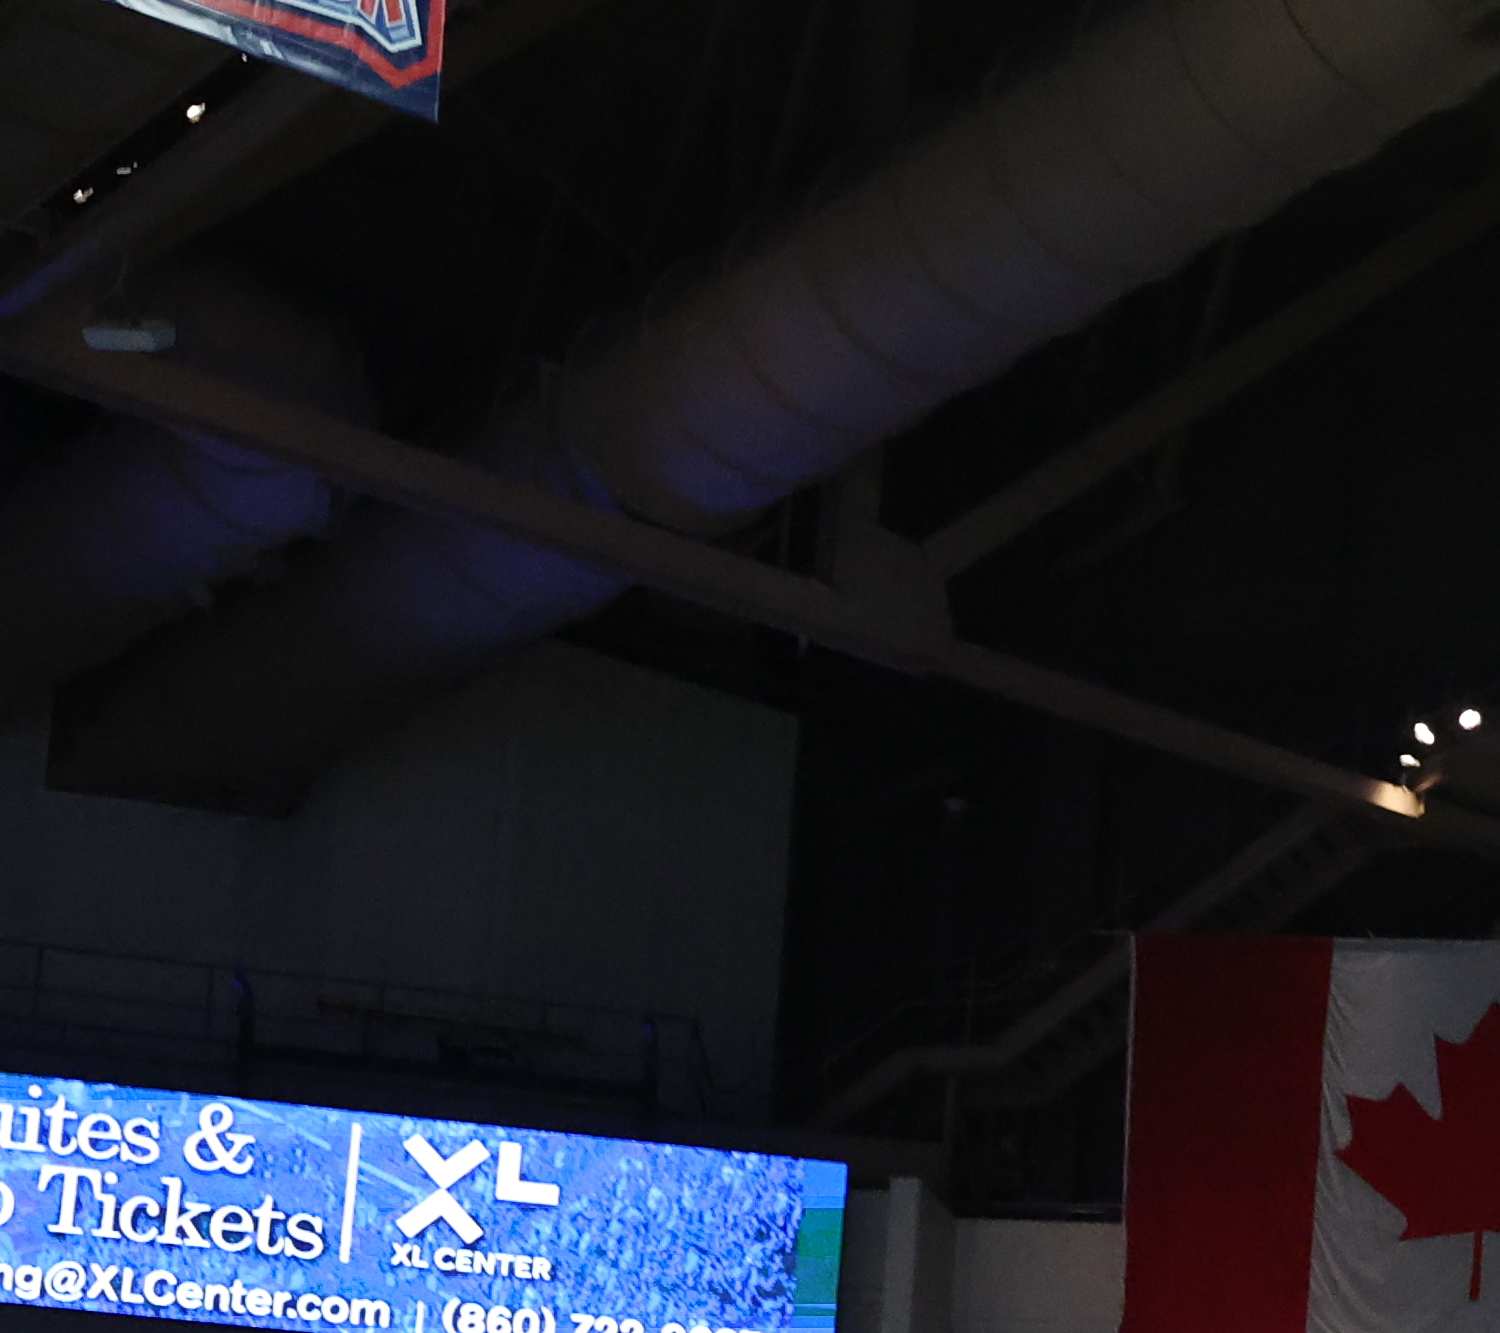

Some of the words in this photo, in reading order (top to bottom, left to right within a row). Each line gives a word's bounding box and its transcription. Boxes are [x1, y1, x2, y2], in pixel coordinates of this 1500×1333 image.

[183, 1102, 256, 1175] &
[37, 1163, 325, 1260] Tickets
[391, 1242, 430, 1271] XL
[433, 1247, 553, 1282] CENTER
